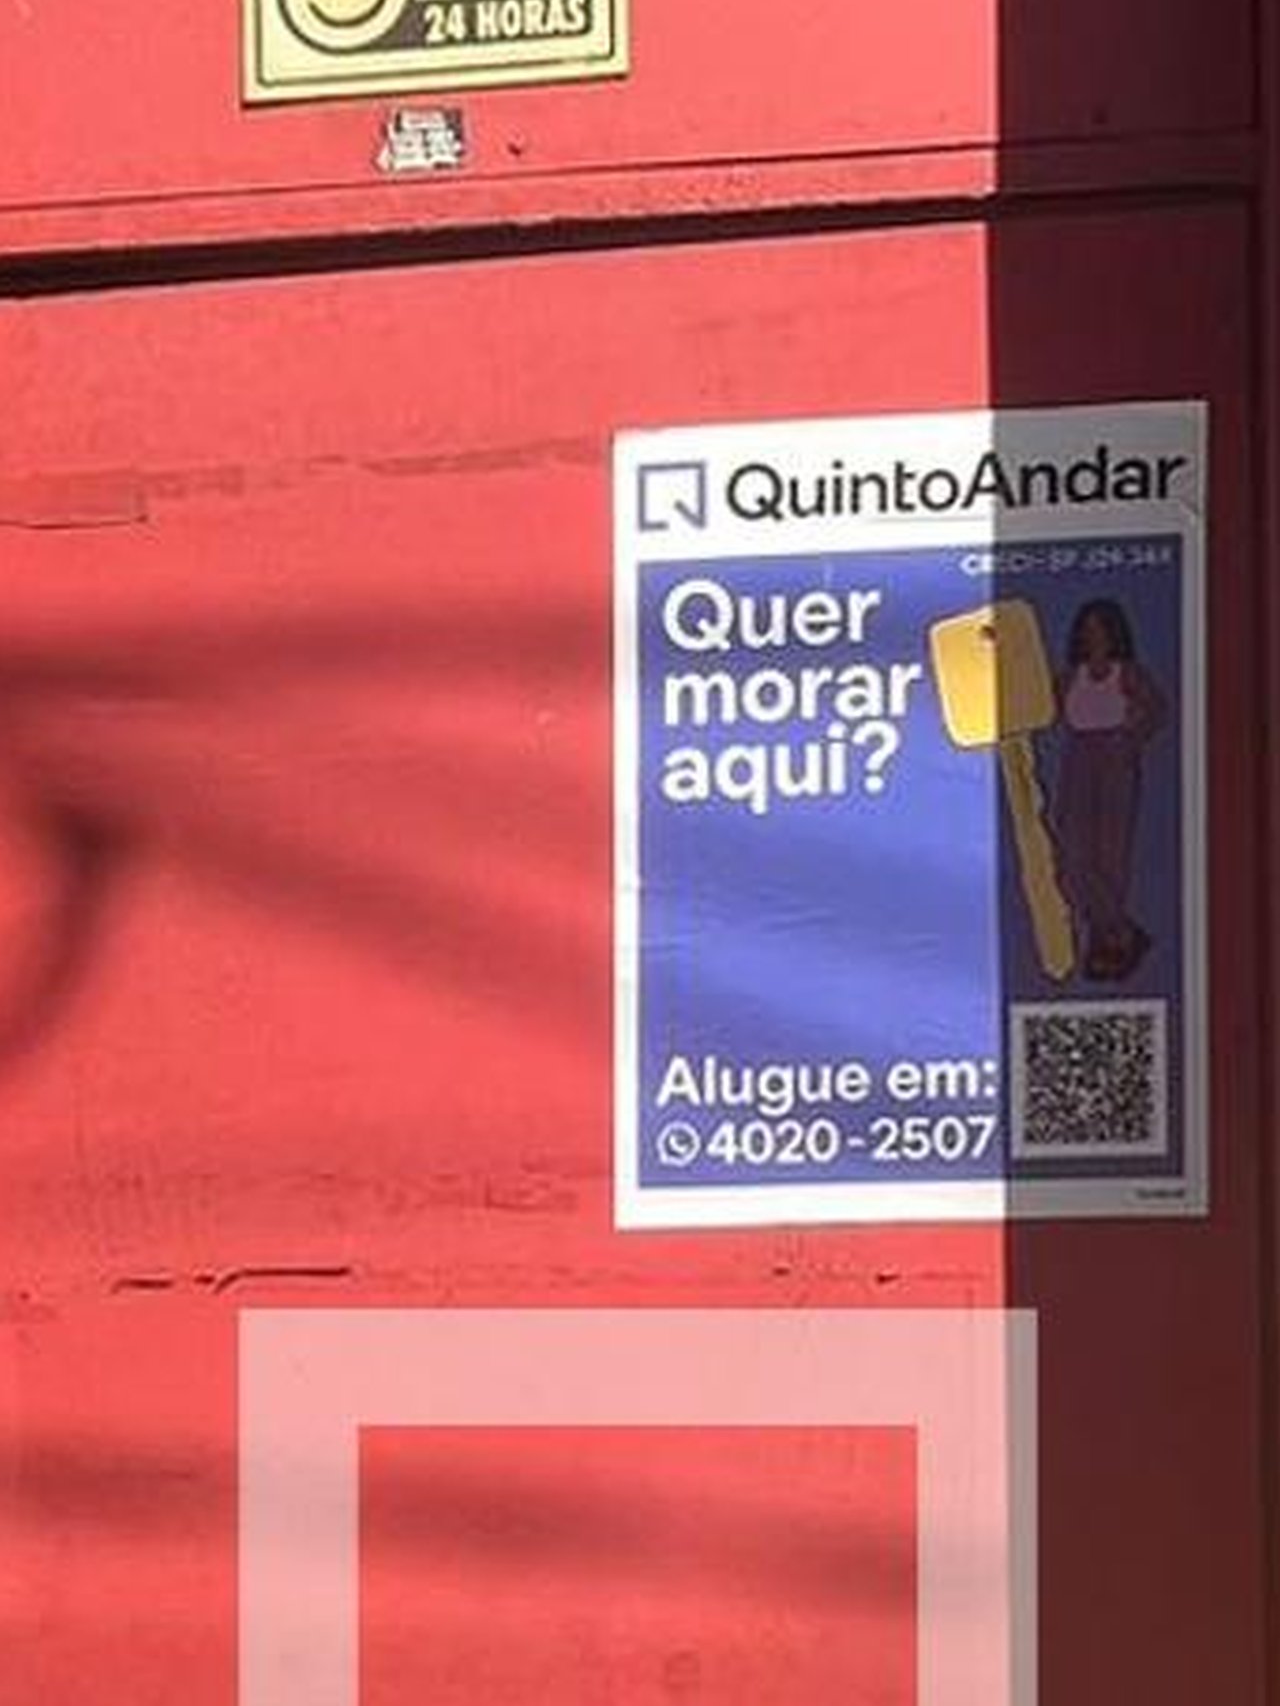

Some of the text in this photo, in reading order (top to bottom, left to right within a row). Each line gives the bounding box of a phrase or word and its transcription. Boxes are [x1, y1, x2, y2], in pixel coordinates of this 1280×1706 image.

[423, 4, 464, 44] 24
[725, 444, 1187, 522] QuintoAndar
[662, 579, 881, 652] Quer
[662, 660, 922, 728] morar
[662, 721, 901, 815] aqui?
[656, 1055, 999, 1117] Alugue em:
